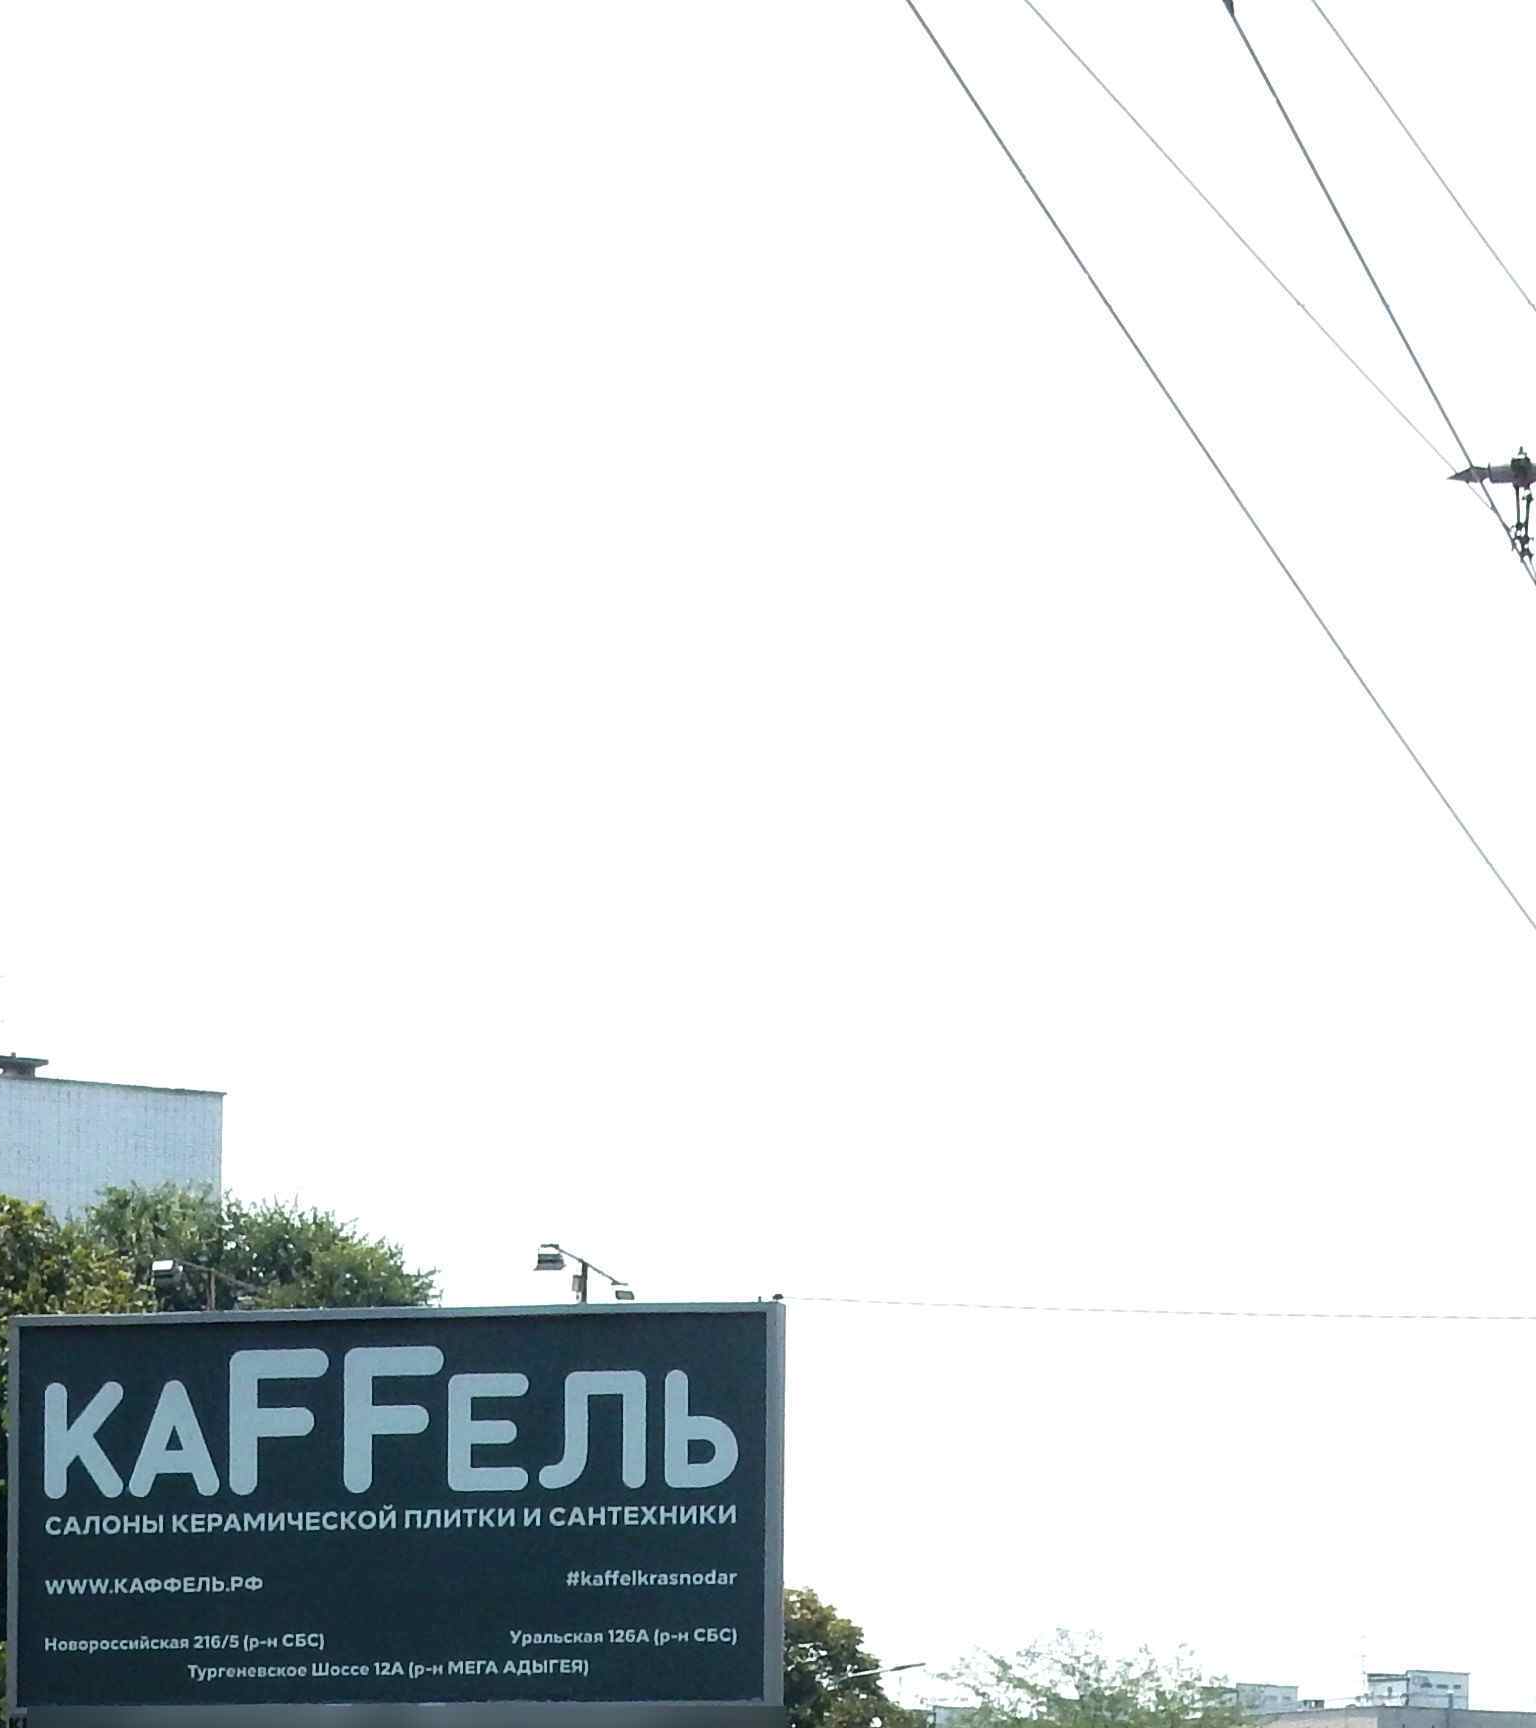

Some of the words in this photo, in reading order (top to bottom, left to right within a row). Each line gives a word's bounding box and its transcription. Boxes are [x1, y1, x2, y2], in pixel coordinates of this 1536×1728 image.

[44, 1514, 164, 1536] САЛОНЫ
[171, 1504, 397, 1533] КЕРАМИЧЕСКОЙ
[404, 1507, 516, 1529] ПЛИТКИ
[523, 1507, 541, 1527] И
[548, 1504, 737, 1527] САНТЕХНИКИ
[44, 1575, 263, 1595] WWW.КАФФЕЛЬ.РФ
[565, 1569, 738, 1587] #kaffelkrasnodar
[44, 1635, 189, 1654] Новороссийская
[193, 1634, 240, 1649] 216/5
[243, 1634, 278, 1652] (р-н
[281, 1633, 325, 1651] СБС)
[509, 1629, 604, 1648] Уральская
[607, 1628, 650, 1643] 126А
[653, 1628, 689, 1647] (р-н
[693, 1627, 738, 1646] СБС)
[187, 1663, 308, 1682] Тургеневское
[311, 1661, 370, 1677] Шоссе
[373, 1661, 405, 1676] 12А
[408, 1661, 444, 1679] (р-н
[447, 1660, 499, 1676] МЕГА
[502, 1659, 590, 1677] АДЫГЕЯ)
